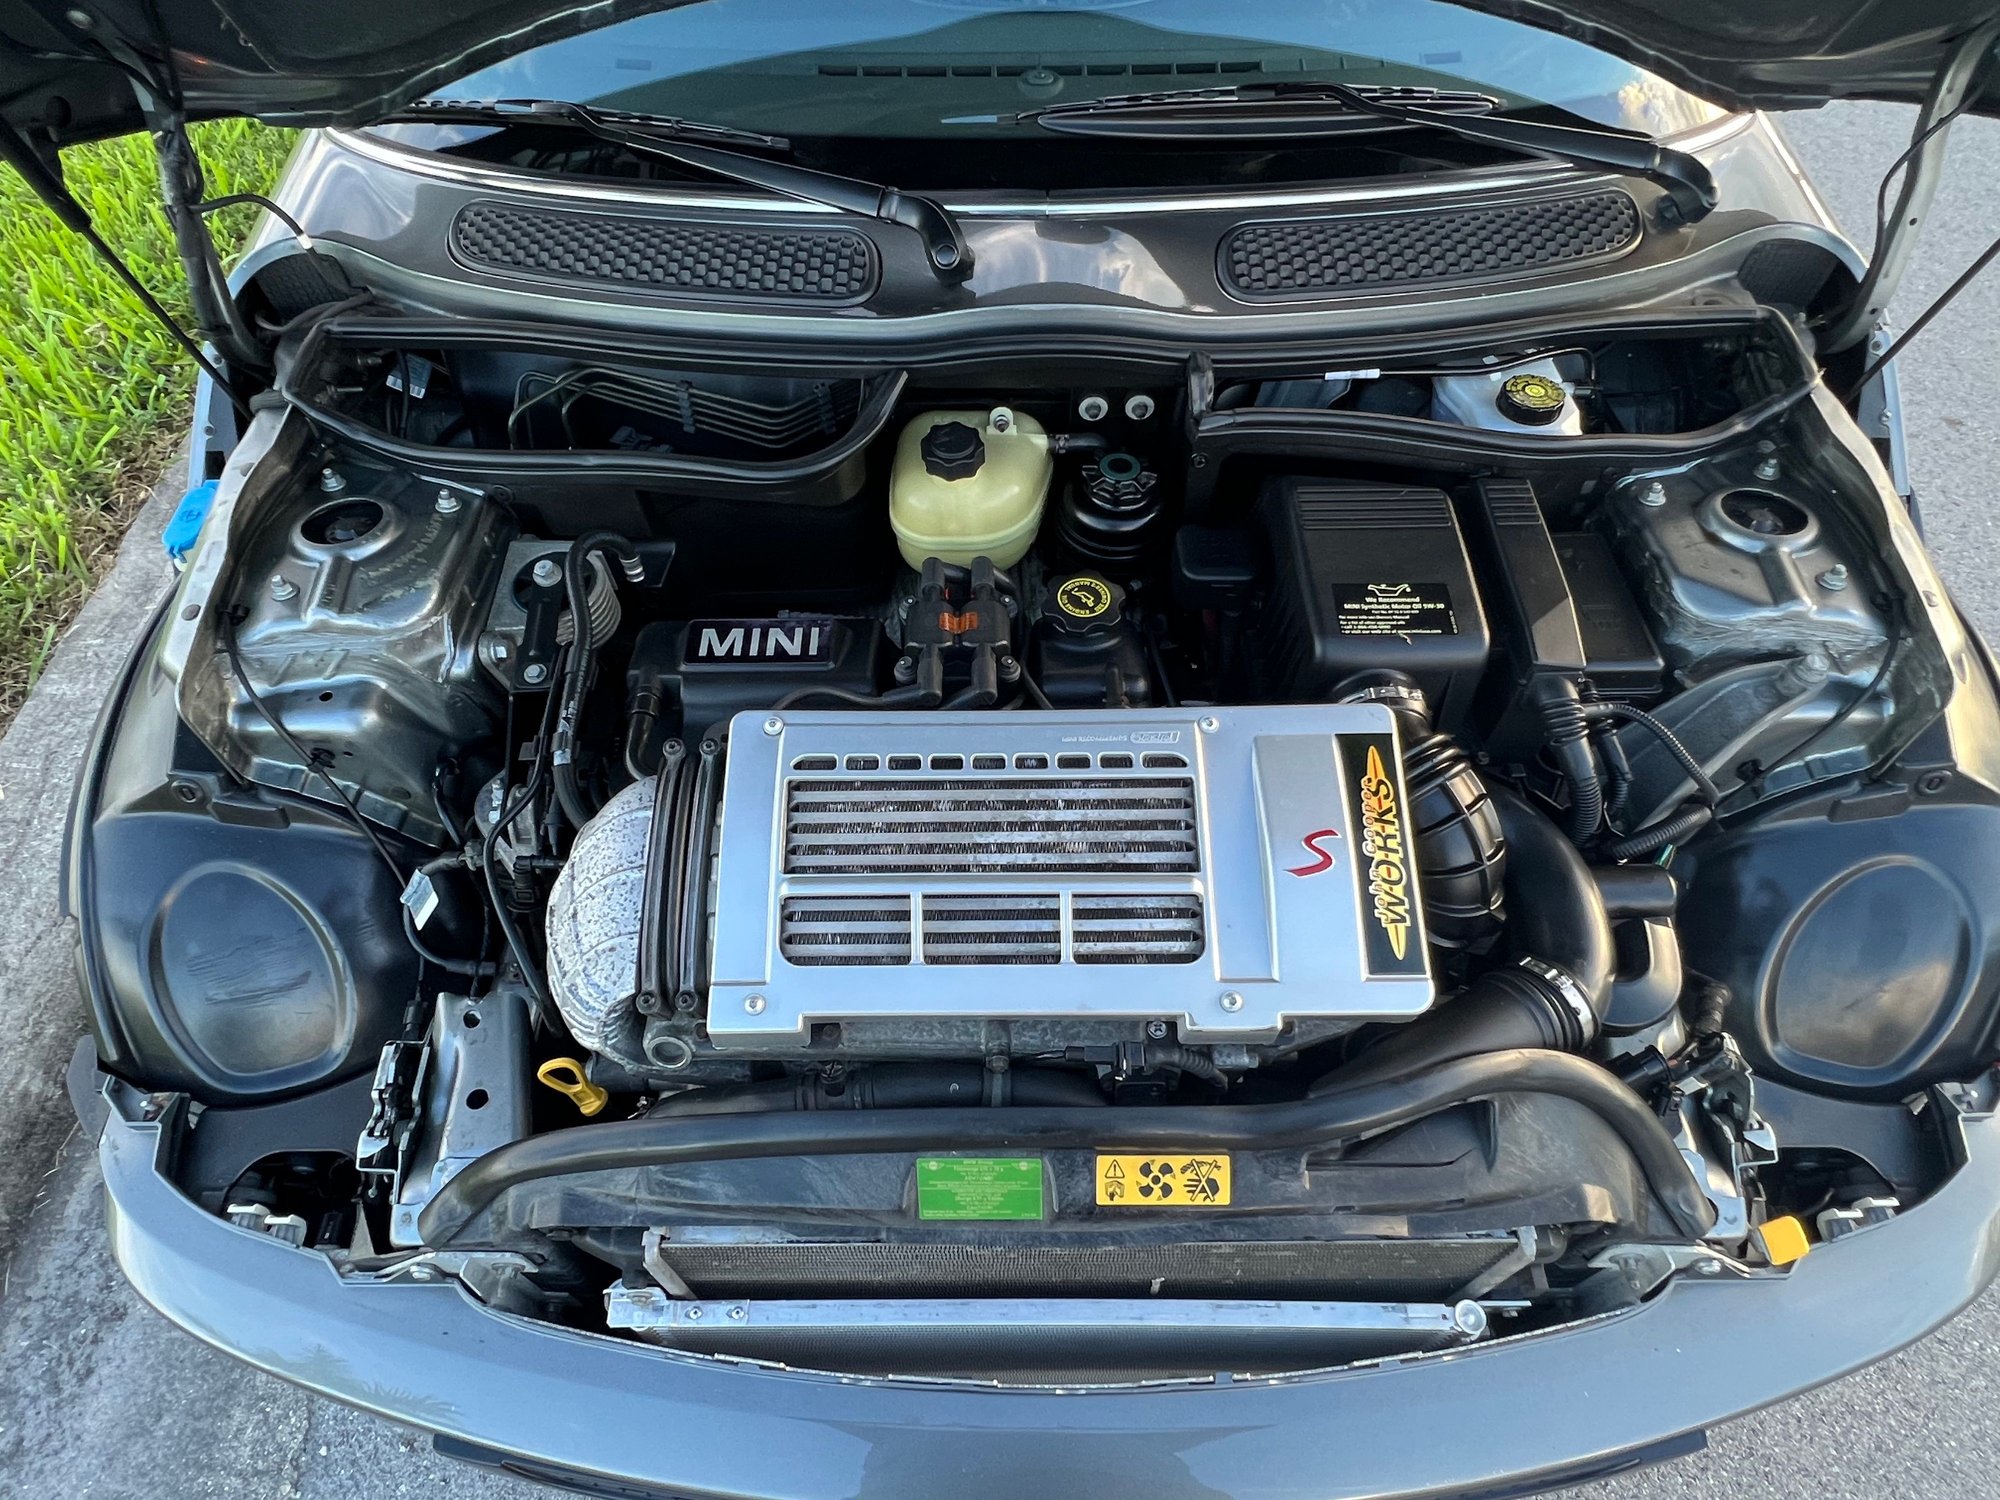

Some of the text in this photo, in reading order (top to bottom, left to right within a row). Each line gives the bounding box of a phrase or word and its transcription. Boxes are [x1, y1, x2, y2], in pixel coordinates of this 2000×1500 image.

[1064, 581, 1090, 592] MANUAL
[1064, 603, 1090, 615] ENGINE
[1361, 603, 1390, 611] Synthetic
[698, 627, 820, 657] MINI
[1284, 829, 1341, 878] S
[1361, 776, 1390, 925] John Cooper
[1371, 777, 1410, 927] WORKS
